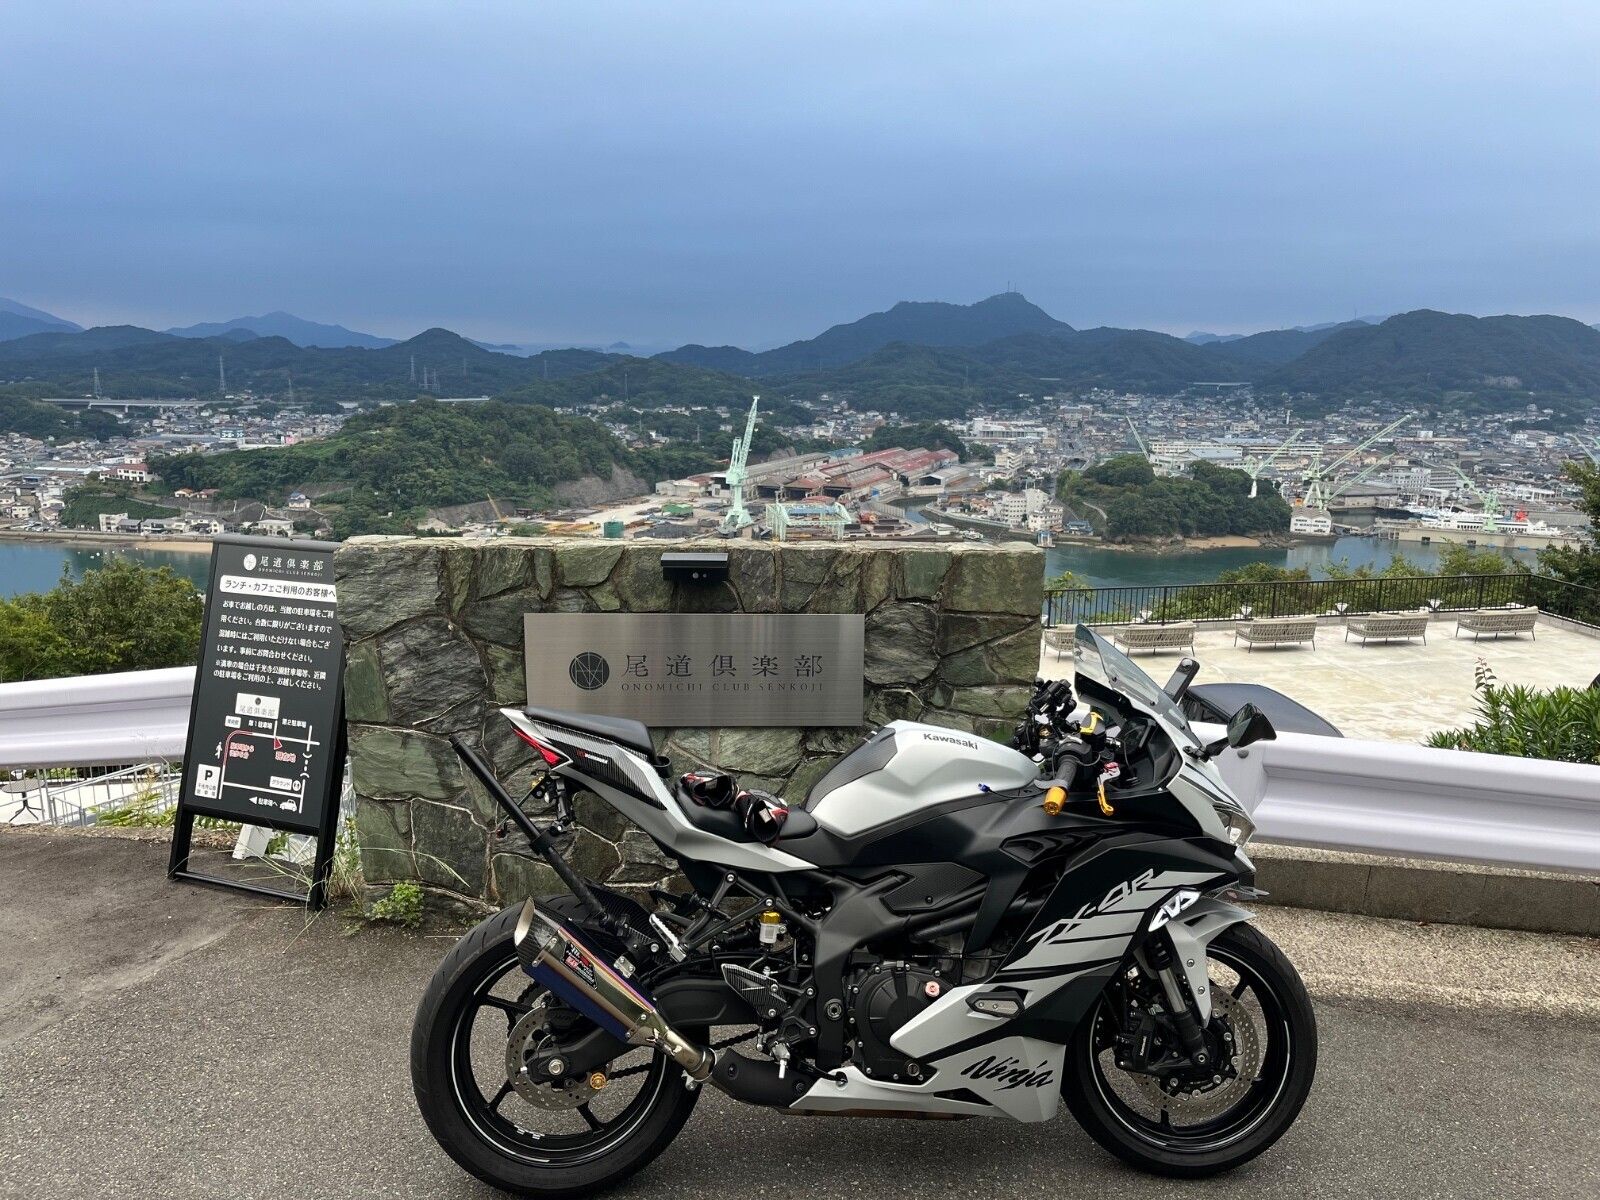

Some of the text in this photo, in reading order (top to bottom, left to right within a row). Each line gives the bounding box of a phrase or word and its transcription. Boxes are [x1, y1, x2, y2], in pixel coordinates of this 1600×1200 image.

[260, 555, 324, 571] 尾道倶楽部
[224, 579, 336, 598] ランチ・カフェご利用のお客様へ
[621, 654, 823, 678] 尾道倶楽部
[621, 682, 824, 692] ONOMICHI CLUB SENKOJI
[923, 733, 979, 750] Kawasaki
[205, 770, 213, 781] P
[960, 1055, 1053, 1092] Ninja
